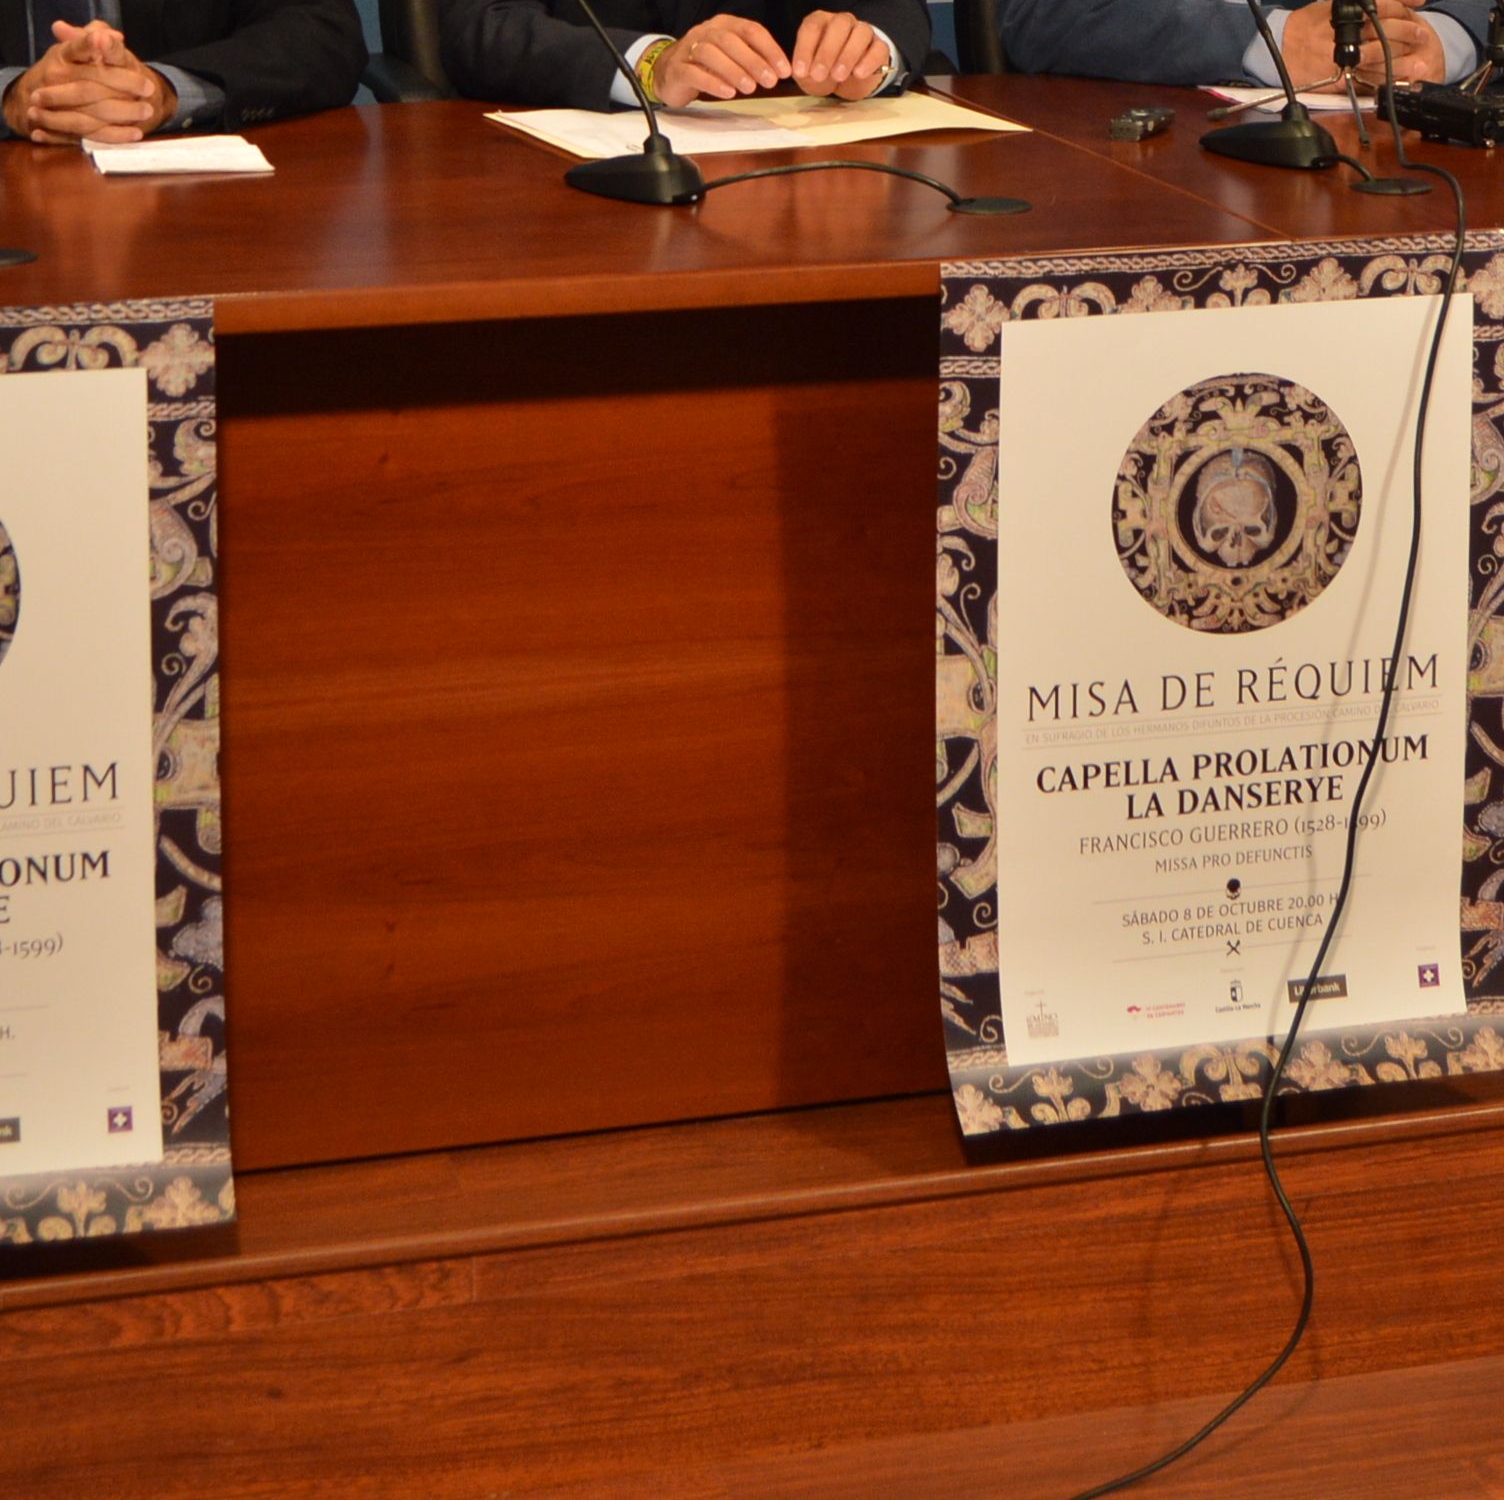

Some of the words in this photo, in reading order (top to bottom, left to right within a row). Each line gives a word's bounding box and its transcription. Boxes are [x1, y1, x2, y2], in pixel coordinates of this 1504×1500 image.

[1027, 678, 1140, 722] MISA
[1161, 671, 1216, 712] DE
[1036, 756, 1181, 793] CAPELLA
[1126, 792, 1165, 820] LA
[1177, 774, 1344, 816] DANSERYE
[1079, 828, 1184, 855] FRANCISCO
[1189, 818, 1289, 844] GUERRERO
[1294, 808, 1387, 836] (1528-199)
[1154, 854, 1198, 873] MISSA
[1202, 851, 1232, 868] PRO
[1235, 844, 1313, 865] DEFUNCTIS
[1122, 907, 1179, 928] SÁBADO
[1183, 908, 1192, 921] 8
[1196, 905, 1214, 920] DE
[1218, 897, 1284, 917] OCTUBRE
[1287, 894, 1325, 910] 20.00
[1142, 931, 1154, 945] S.
[1171, 922, 1241, 942] CATEDRAL
[1245, 920, 1264, 934] DE
[1267, 913, 1324, 931] CUENCA
[0, 1025, 16, 1041] H.
